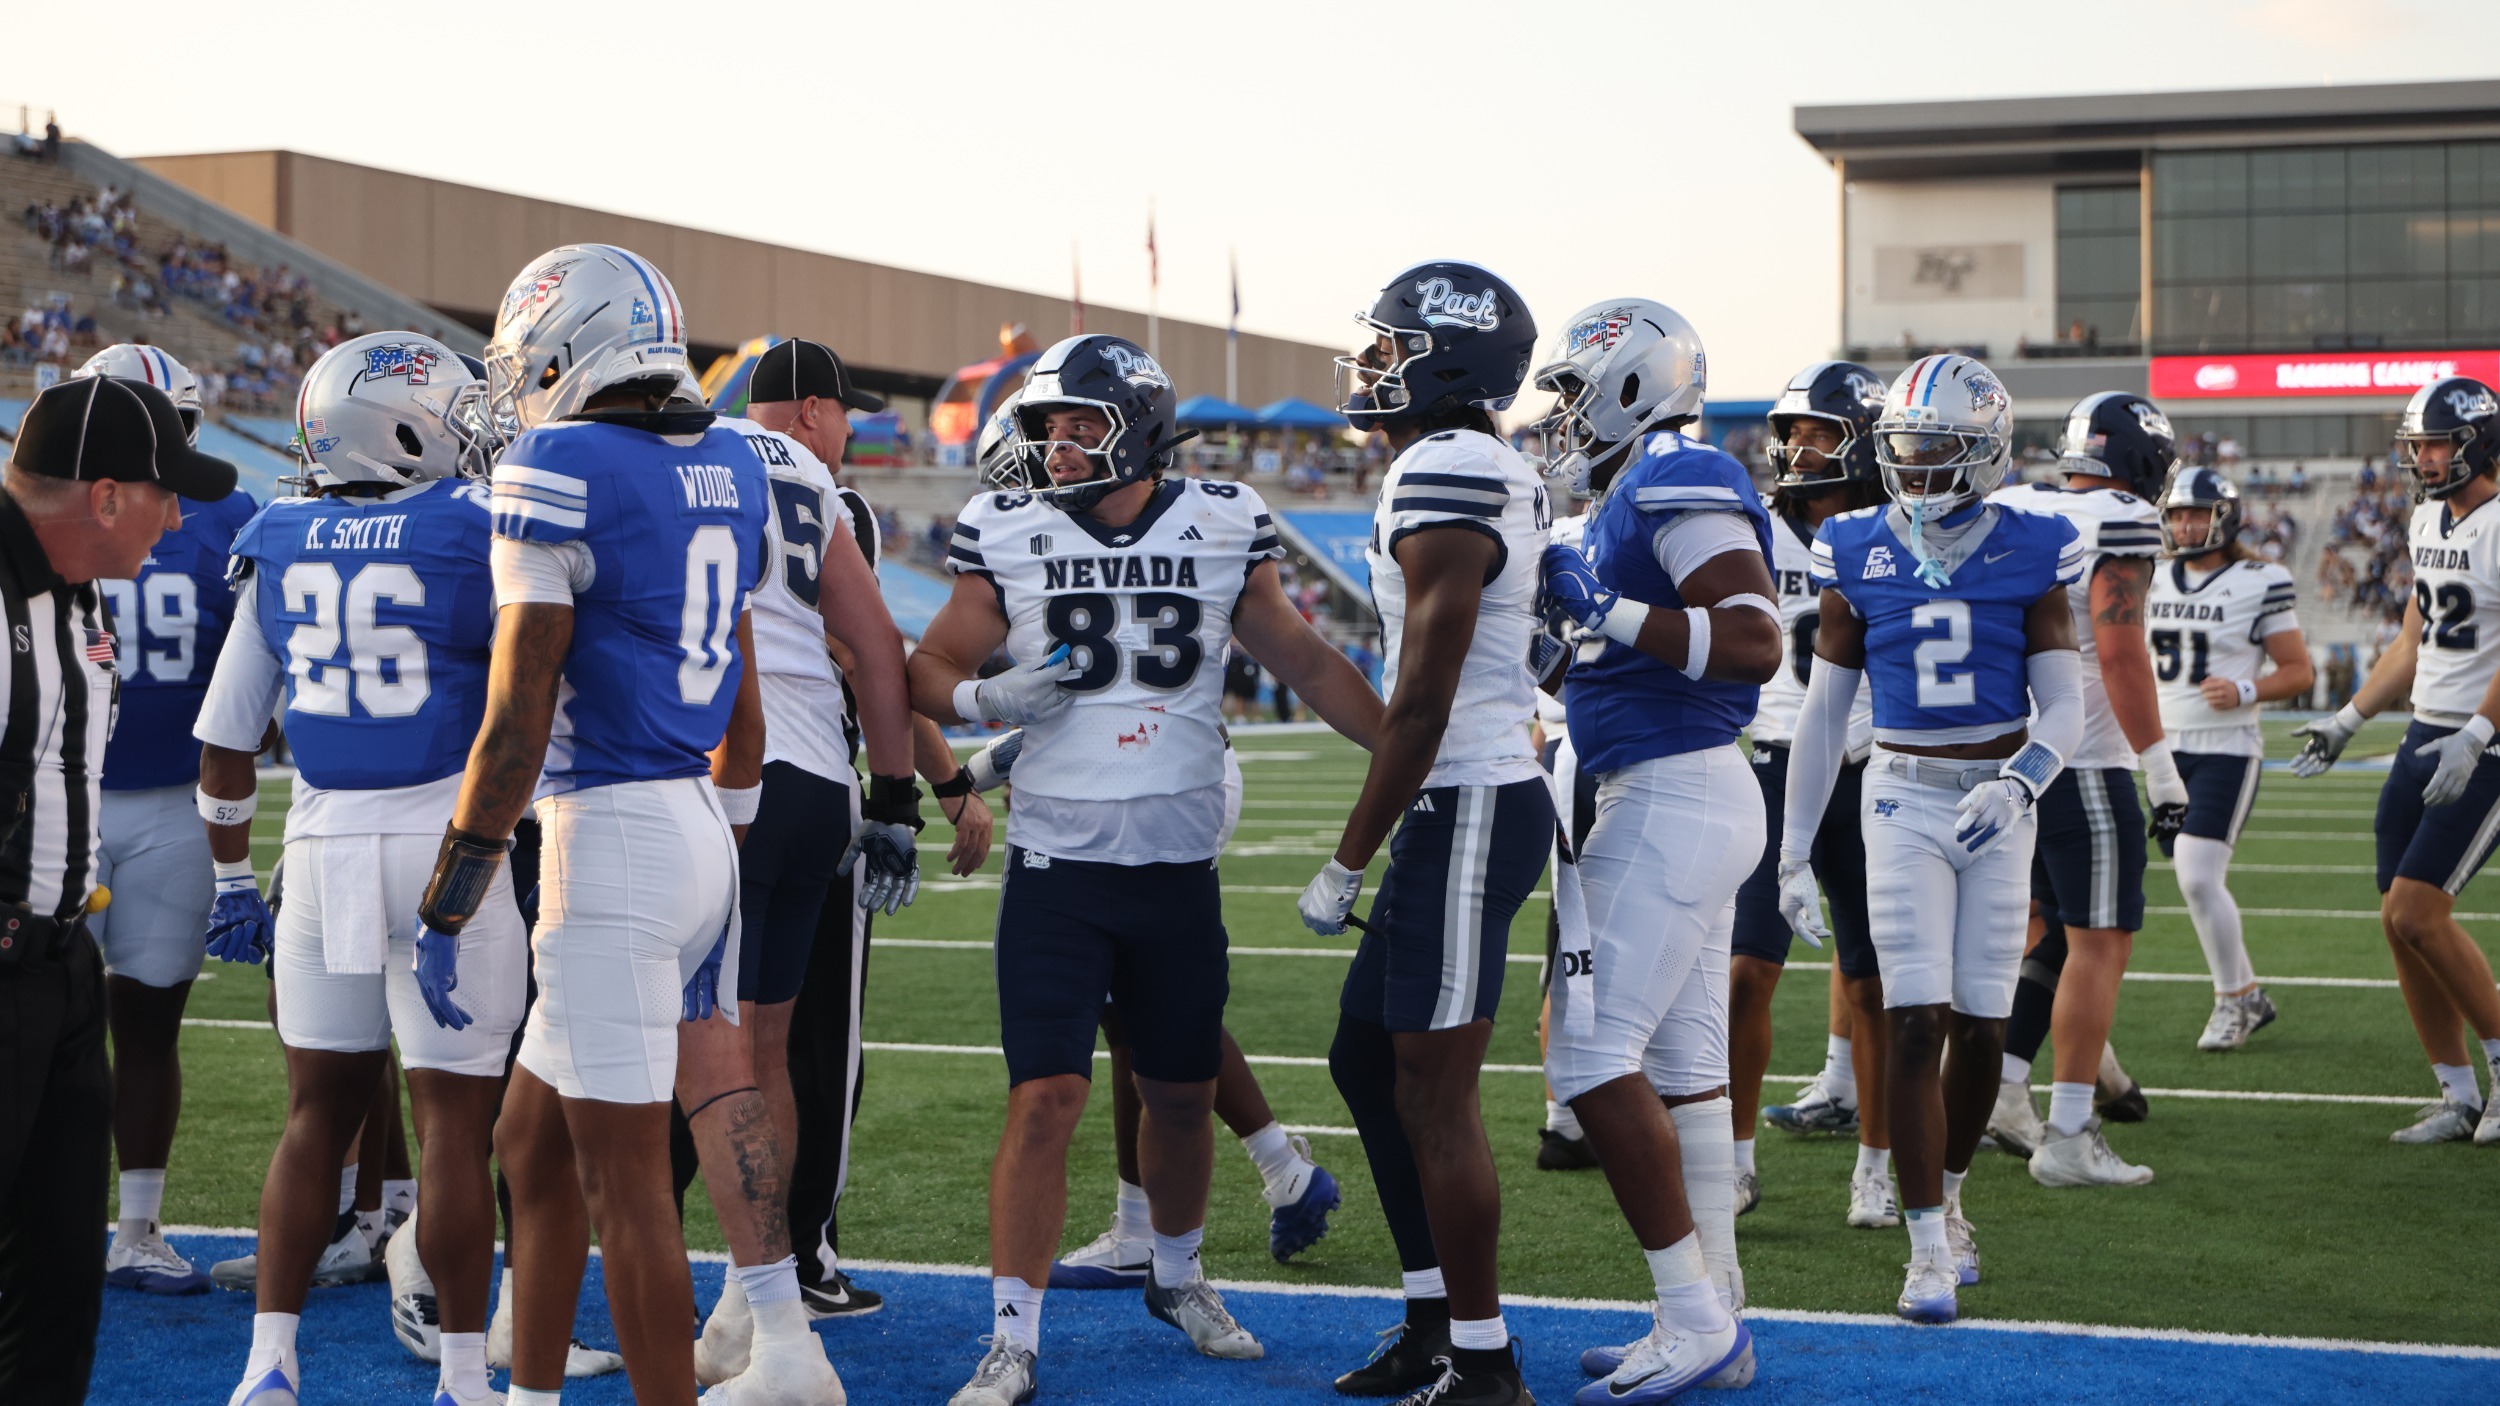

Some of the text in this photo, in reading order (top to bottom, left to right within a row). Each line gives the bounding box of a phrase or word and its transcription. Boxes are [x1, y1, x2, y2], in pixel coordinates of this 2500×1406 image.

[1415, 276, 1500, 332] Pack
[647, 346, 664, 355] BLUE
[2445, 387, 2499, 422] Pack
[315, 438, 332, 453] 26
[676, 465, 739, 509] WOODS
[305, 514, 407, 550] K. SMITH
[1043, 555, 1200, 591] NEVADA
[1862, 563, 1897, 580] USA
[2414, 546, 2471, 571] NEVADA
[677, 525, 739, 705] 0
[2150, 602, 2225, 623] NEVADA
[281, 562, 432, 719] 26
[1042, 592, 1206, 697] 83
[1911, 599, 1976, 708] 2
[2151, 628, 2211, 685] 51
[215, 806, 238, 821] 52
[1023, 849, 1051, 869] Pack
